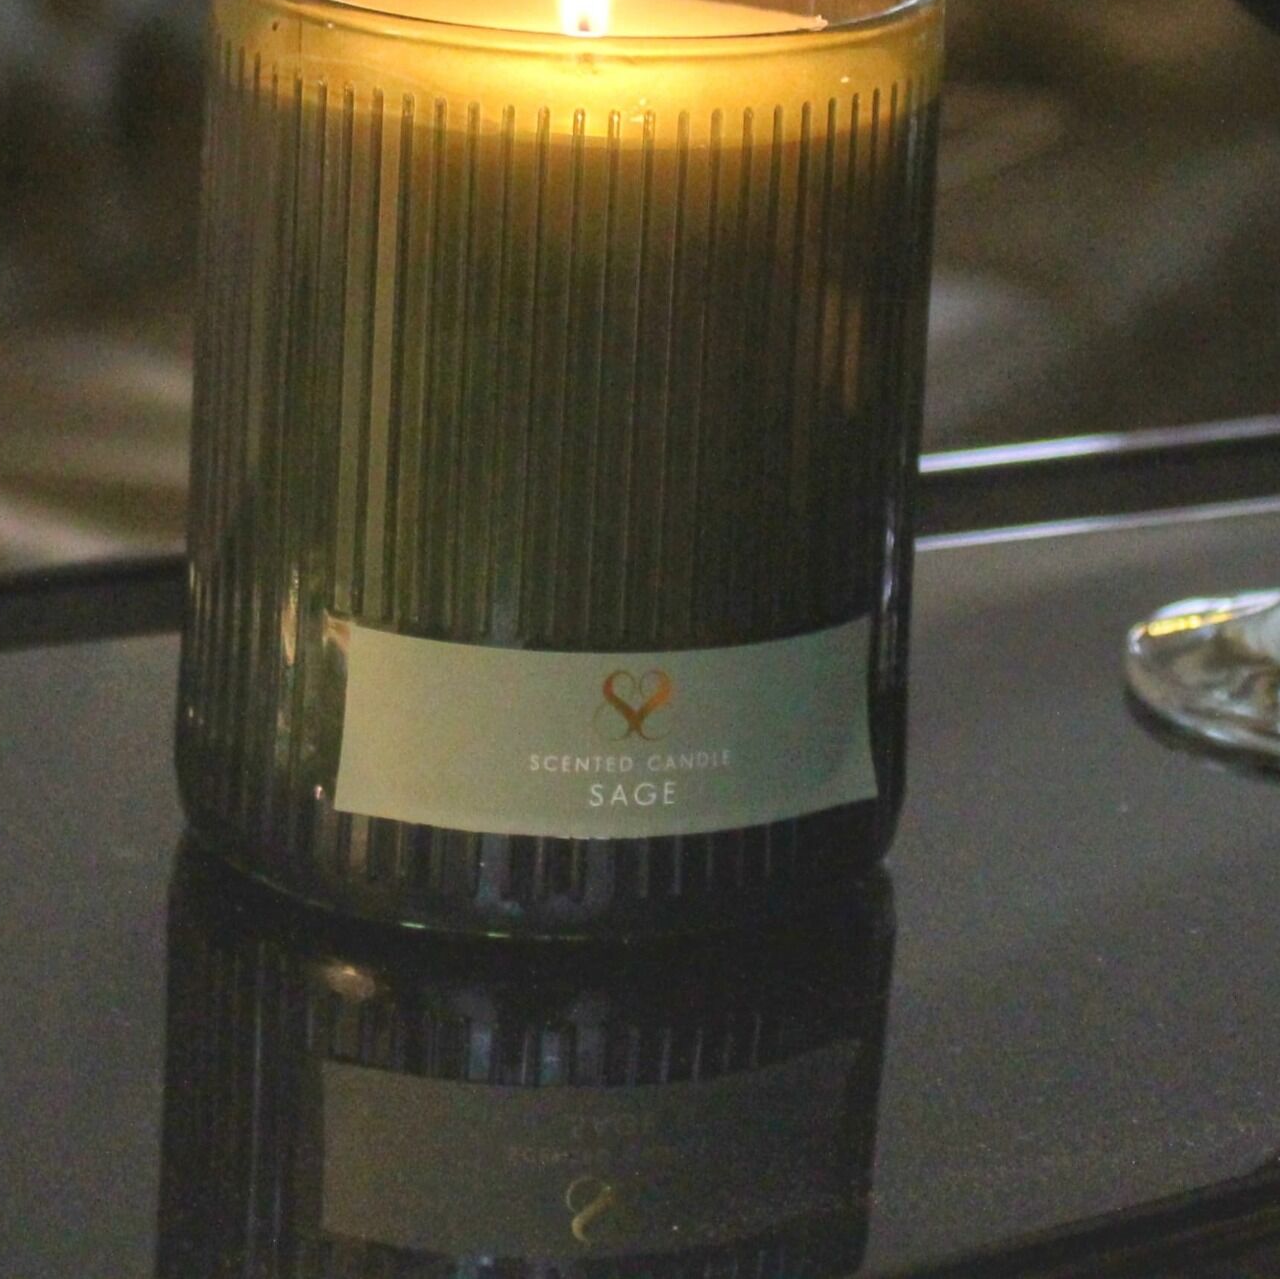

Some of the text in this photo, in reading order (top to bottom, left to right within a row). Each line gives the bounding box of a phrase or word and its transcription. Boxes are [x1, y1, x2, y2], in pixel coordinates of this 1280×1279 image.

[528, 749, 732, 773] SCENTED CANDLE
[588, 780, 678, 808] SAGE
